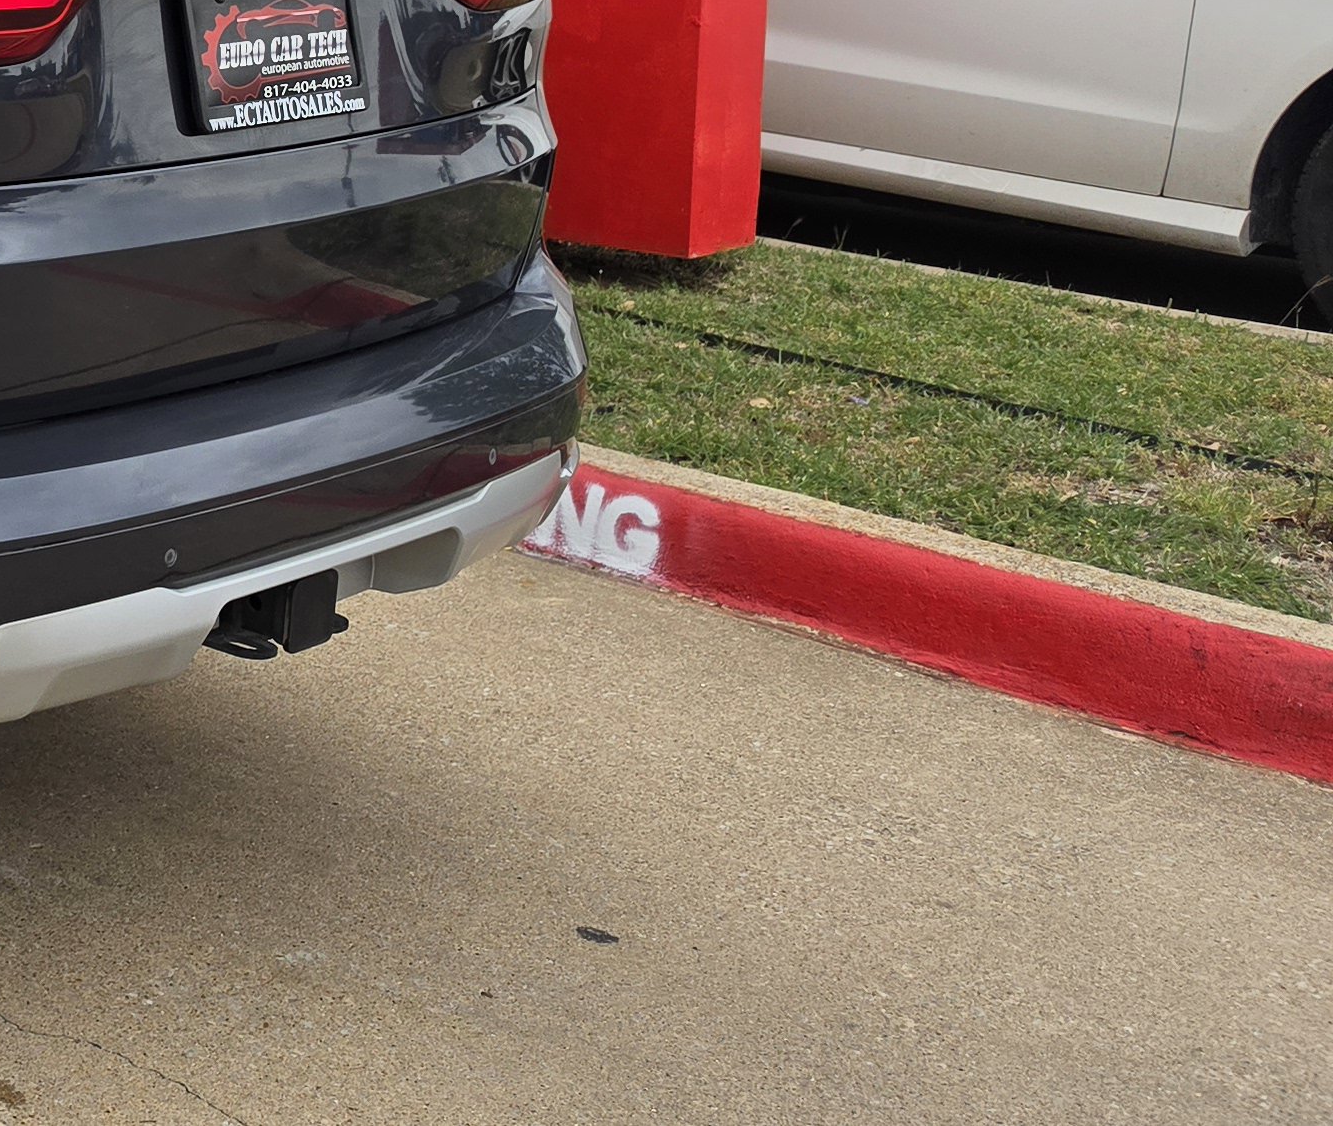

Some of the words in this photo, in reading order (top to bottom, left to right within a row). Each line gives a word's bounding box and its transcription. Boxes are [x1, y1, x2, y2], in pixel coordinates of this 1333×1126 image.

[219, 39, 266, 70] EURO
[270, 34, 304, 63] CAR
[307, 29, 348, 58] TECH
[261, 60, 302, 76] european
[303, 54, 350, 70] automotive
[263, 75, 353, 98] 817-404-4033
[208, 91, 366, 132] www.ECTAUTOSALES.com
